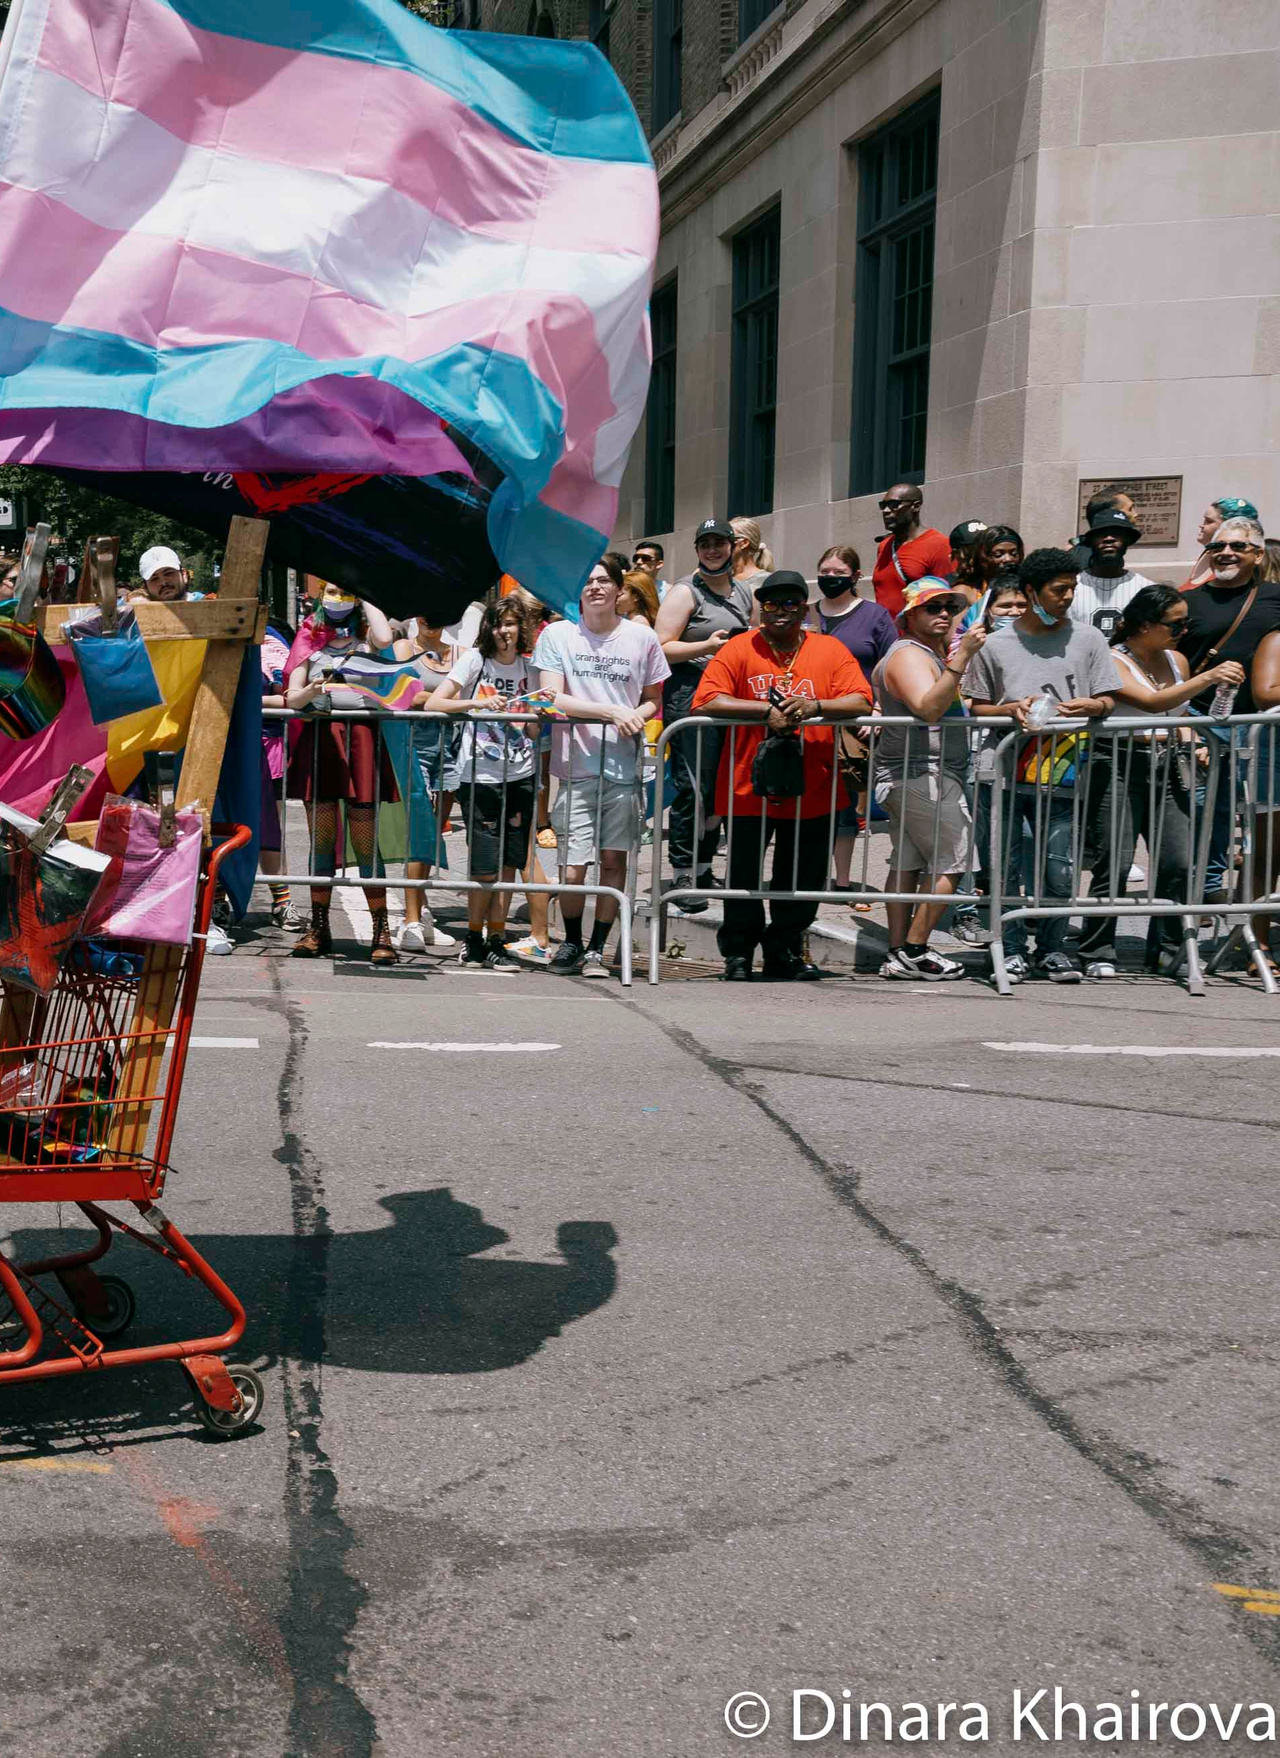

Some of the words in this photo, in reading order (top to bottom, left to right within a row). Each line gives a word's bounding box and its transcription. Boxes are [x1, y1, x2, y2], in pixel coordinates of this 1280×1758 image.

[575, 653, 599, 662] trans
[601, 656, 630, 666] rights
[594, 663, 609, 671] are
[573, 668, 601, 679] human
[604, 671, 630, 682] rights
[747, 674, 816, 700] USA
